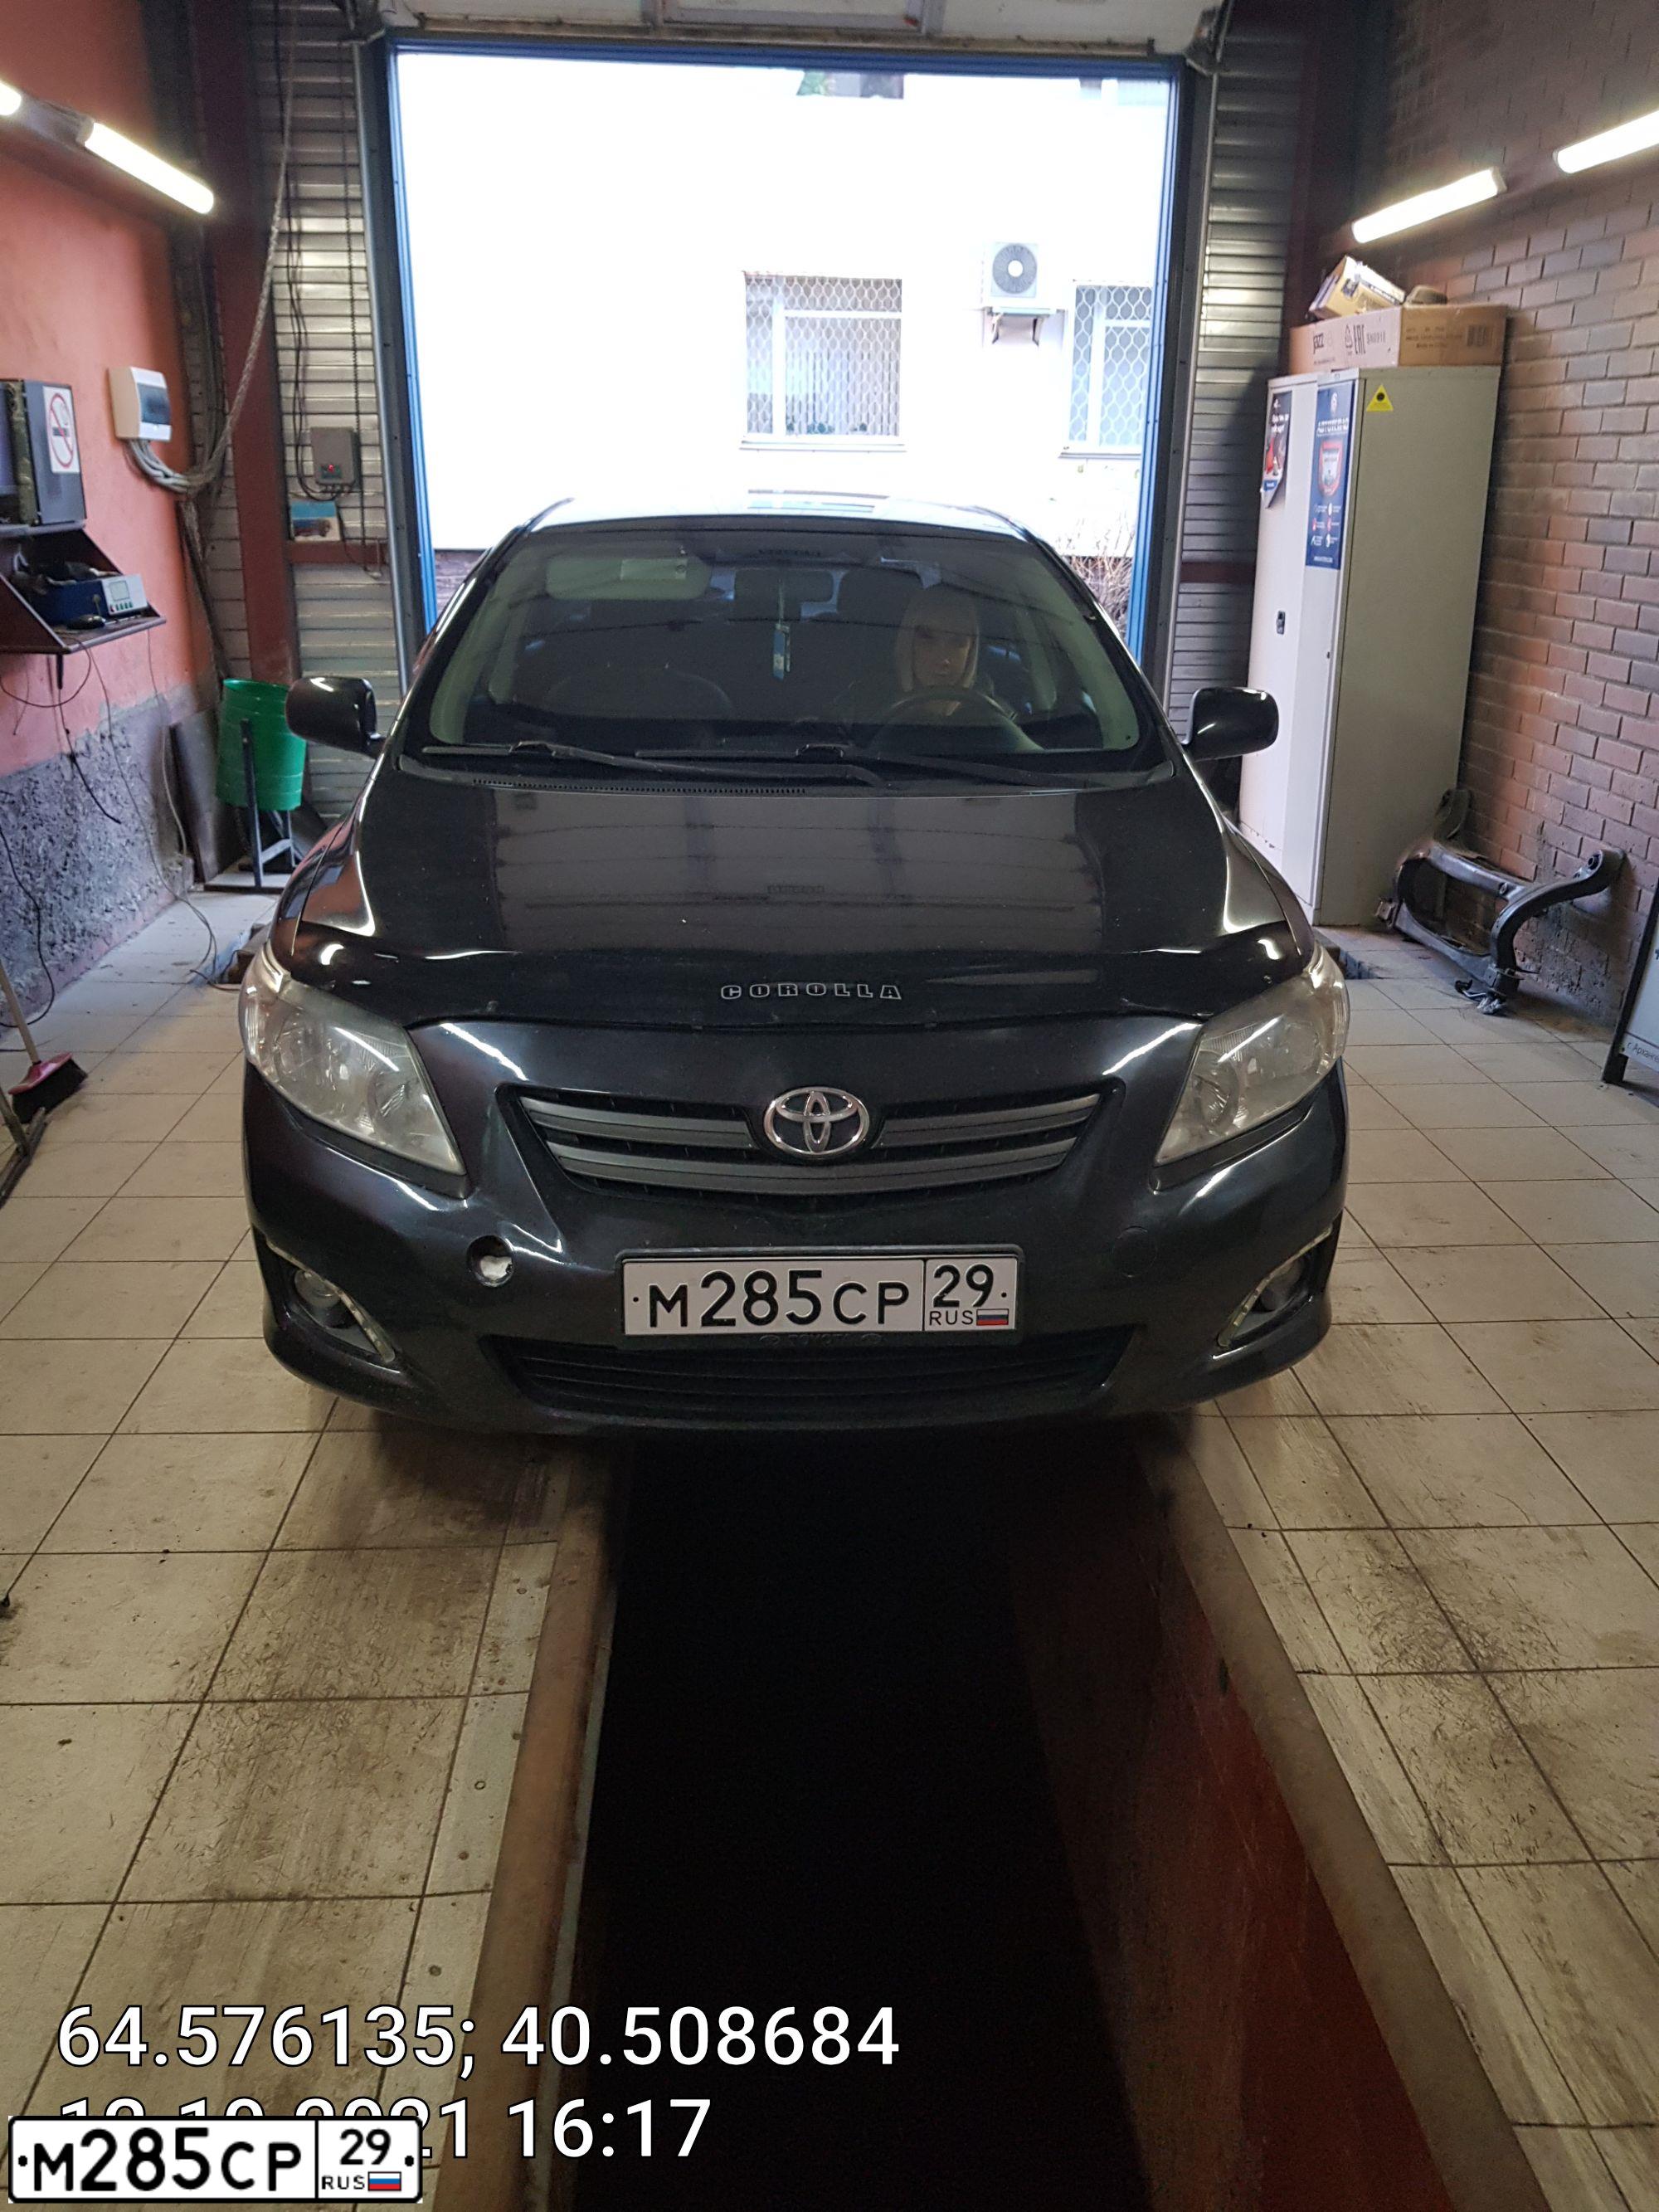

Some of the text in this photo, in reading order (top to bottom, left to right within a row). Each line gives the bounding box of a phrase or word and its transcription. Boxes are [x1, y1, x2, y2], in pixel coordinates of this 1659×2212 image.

[721, 982, 902, 1000] COROLLA
[932, 1264, 995, 1308] 29
[929, 1309, 974, 1326] RUS
